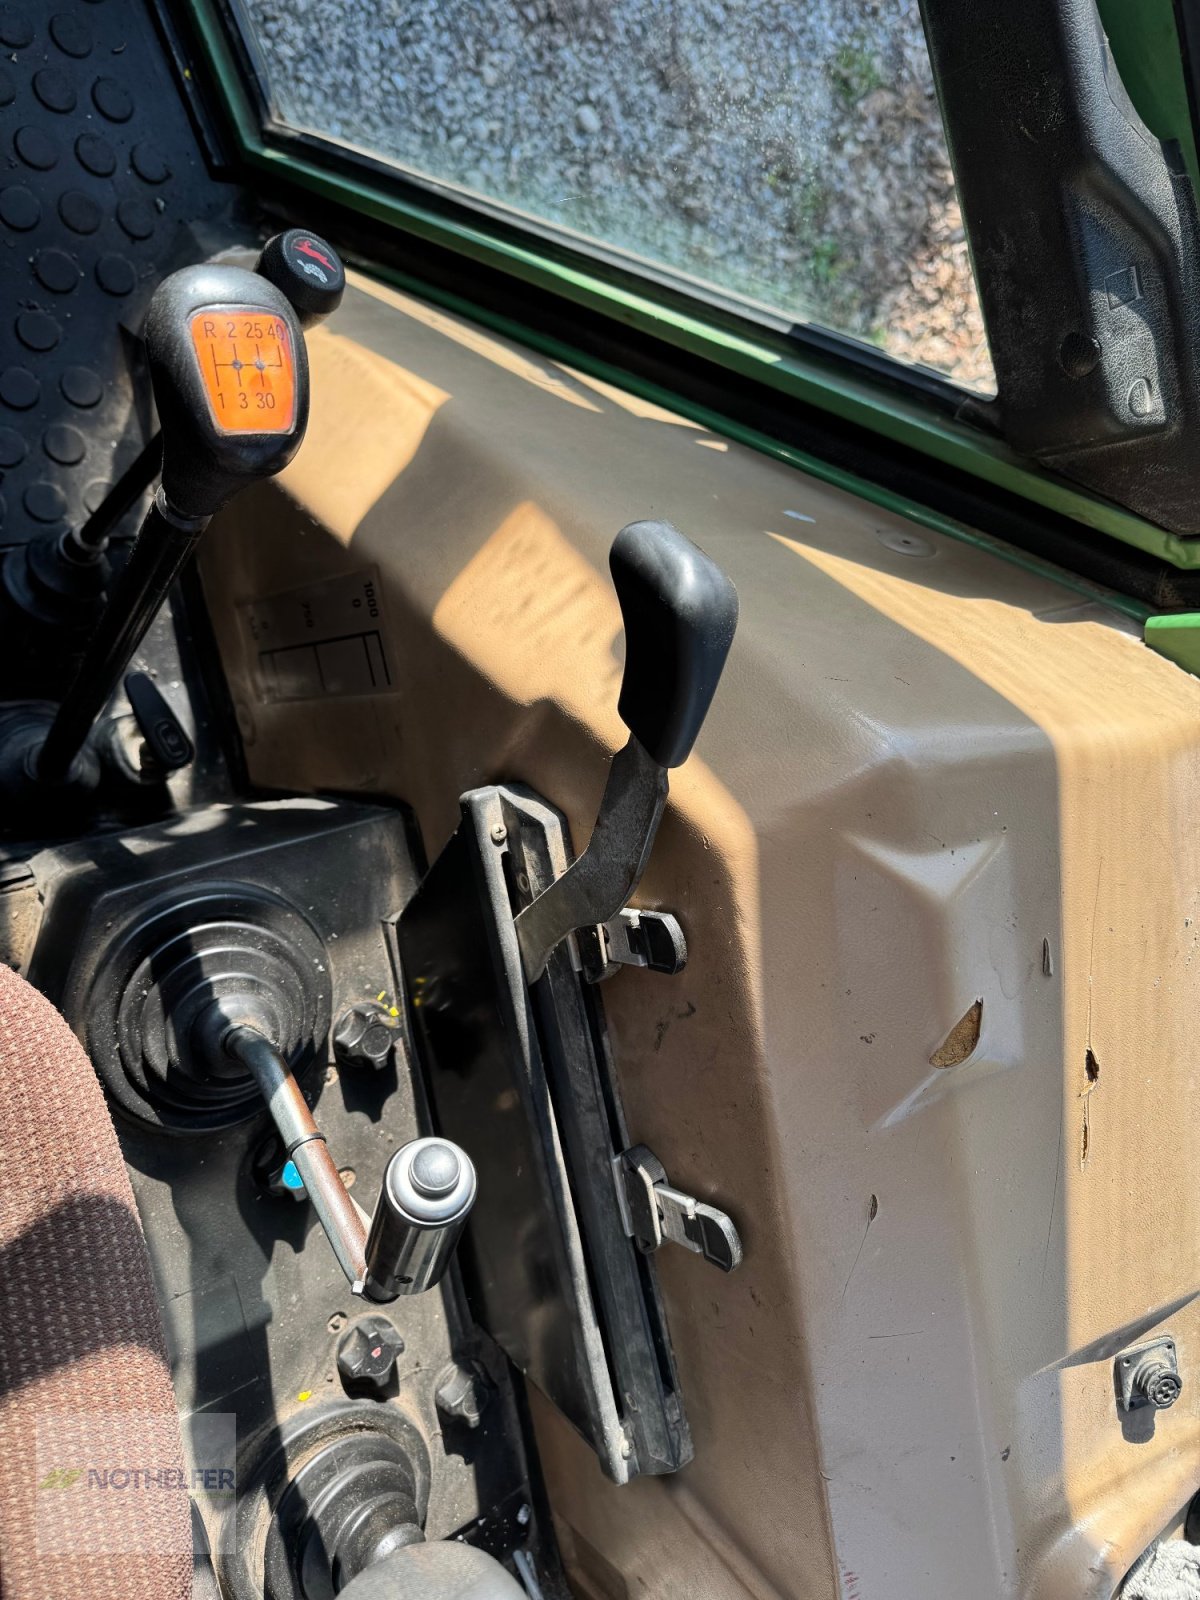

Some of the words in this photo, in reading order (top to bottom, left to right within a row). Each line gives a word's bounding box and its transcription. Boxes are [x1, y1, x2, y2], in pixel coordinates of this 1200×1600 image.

[203, 321, 217, 339] R
[226, 321, 238, 338] 2
[244, 321, 263, 339] 25
[267, 323, 285, 341] 40
[217, 392, 225, 410] 1
[238, 392, 249, 410] 3
[255, 392, 276, 409] 30
[363, 580, 379, 618] 1000
